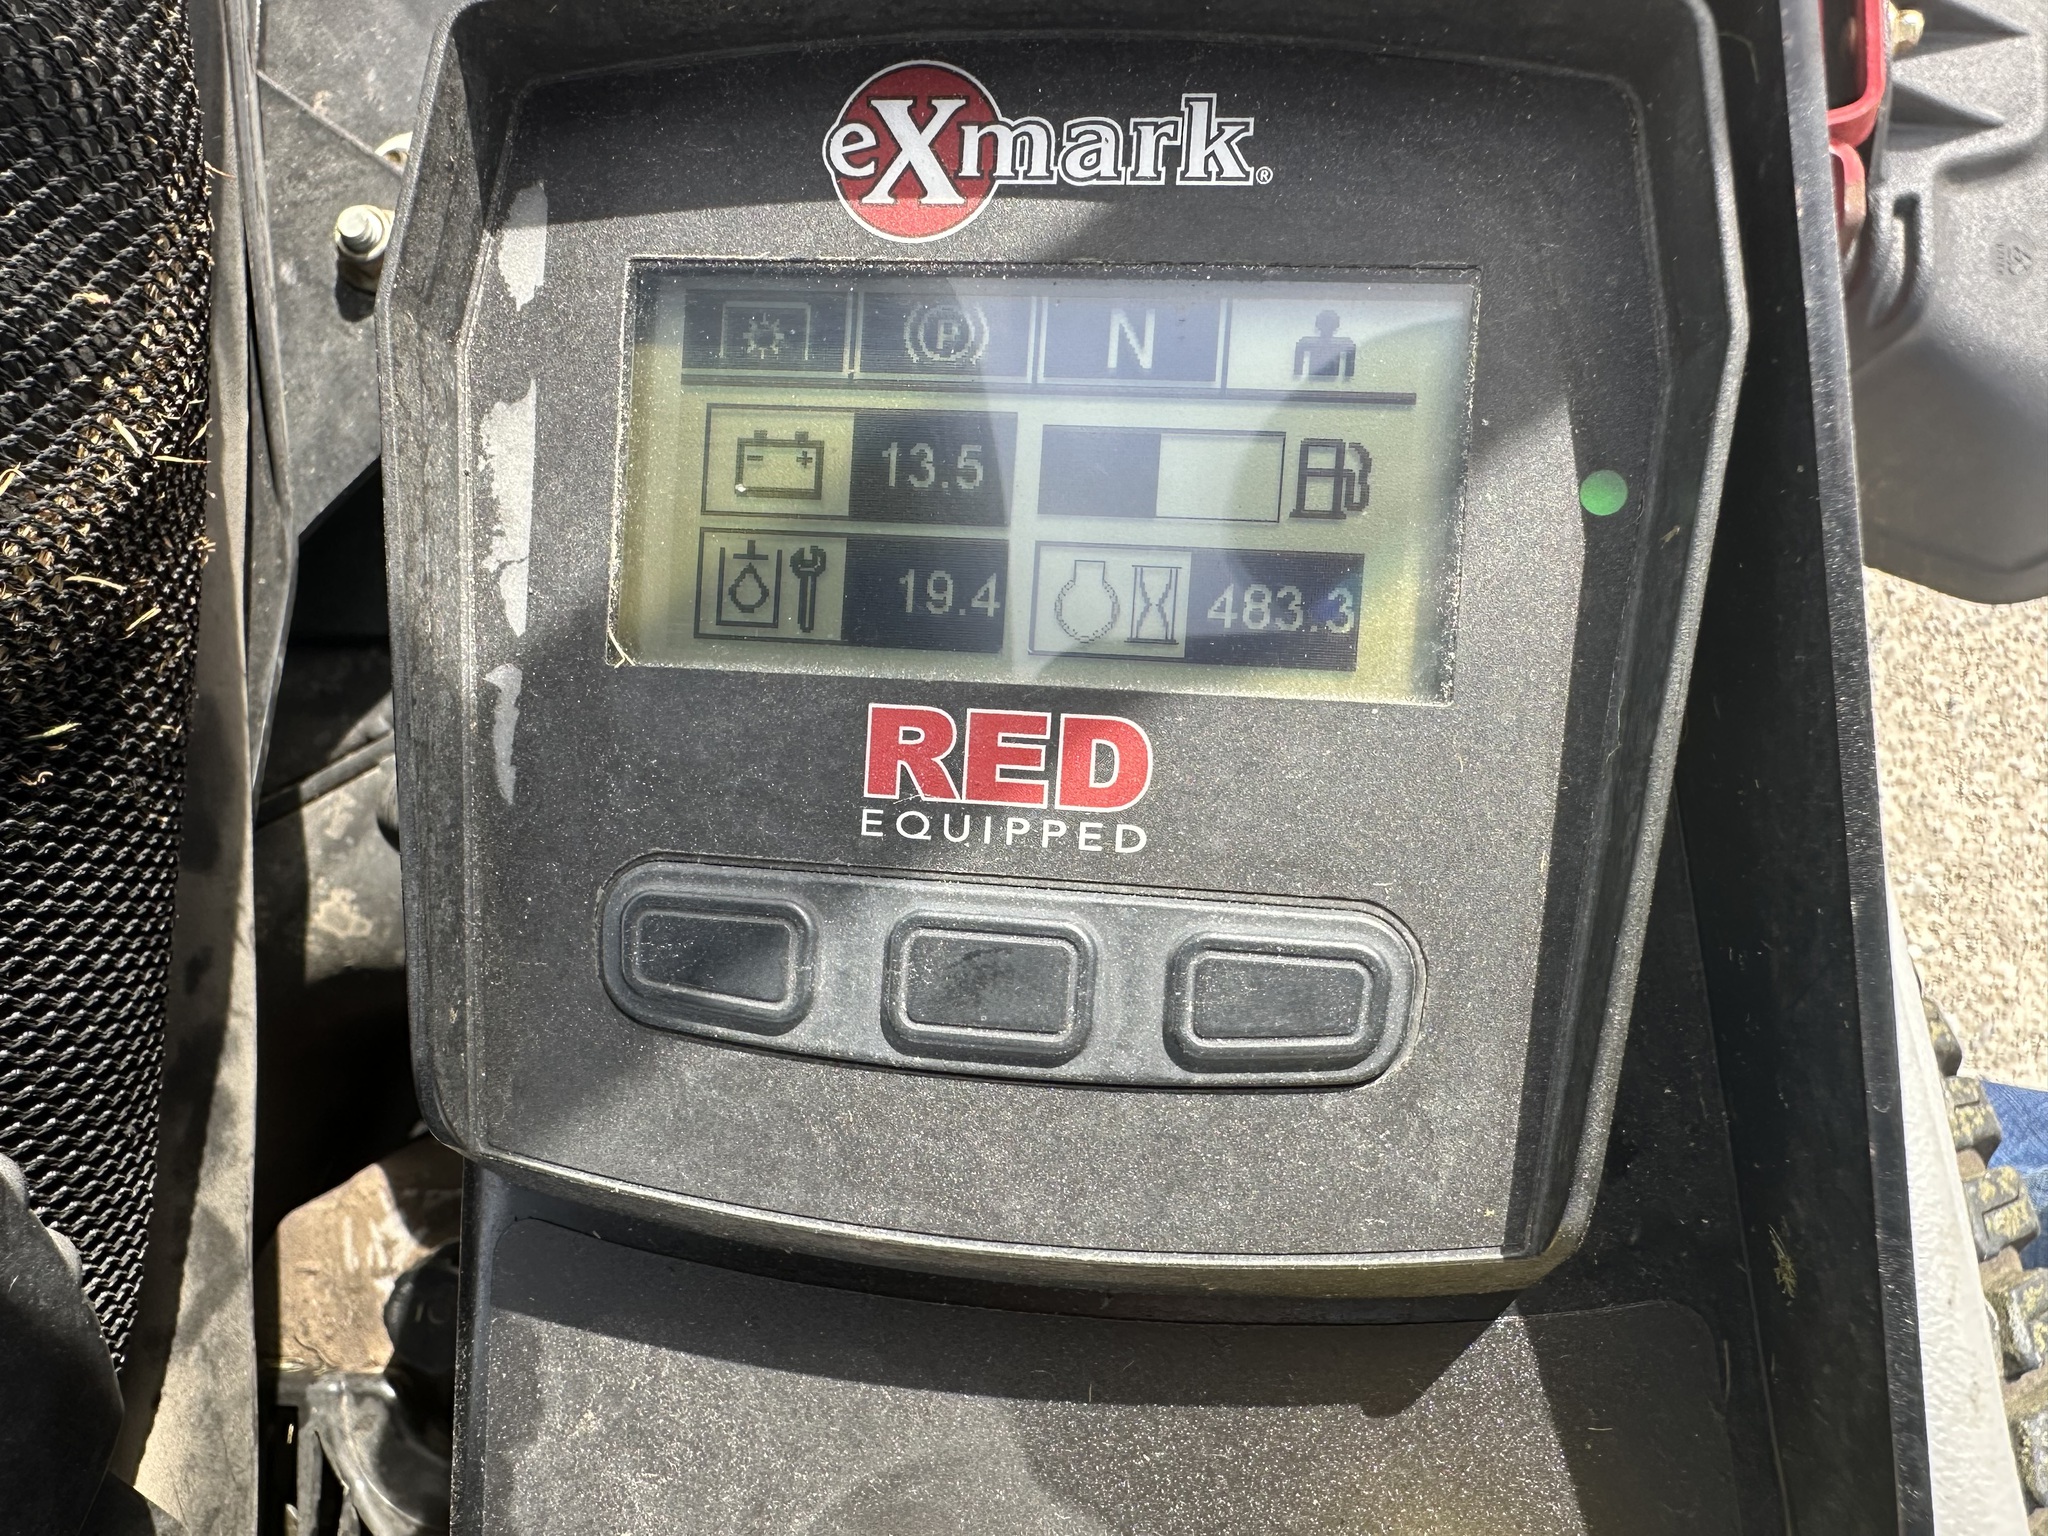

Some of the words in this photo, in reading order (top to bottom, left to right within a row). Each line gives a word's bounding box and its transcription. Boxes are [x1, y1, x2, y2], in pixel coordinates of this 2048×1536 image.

[1107, 309, 1155, 369] N
[882, 442, 984, 490] 13.5
[899, 569, 1000, 617] 19.4
[1207, 583, 1355, 633] 483.3
[863, 702, 1153, 813] RED
[860, 808, 1148, 853] EQUIPPED
